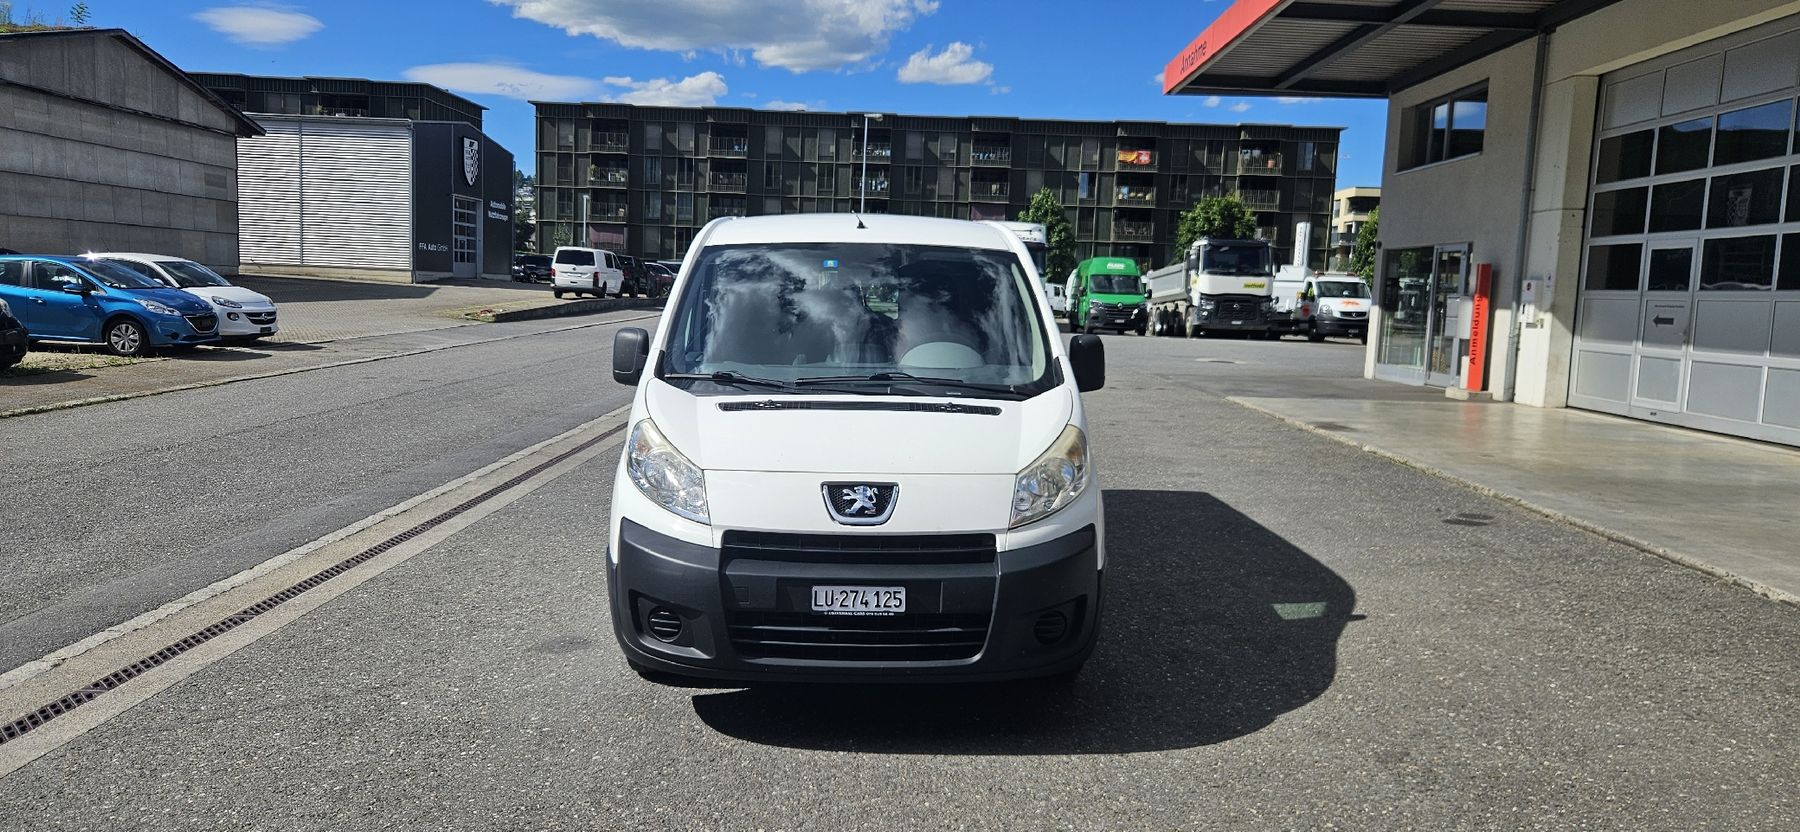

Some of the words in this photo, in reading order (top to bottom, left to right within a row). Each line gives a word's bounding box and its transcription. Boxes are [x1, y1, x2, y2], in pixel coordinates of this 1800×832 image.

[1180, 41, 1207, 74] Annahme
[419, 242, 427, 250] FFA
[428, 243, 436, 251] Auto
[1469, 295, 1483, 365] Anmeldung
[874, 590, 903, 608] 125
